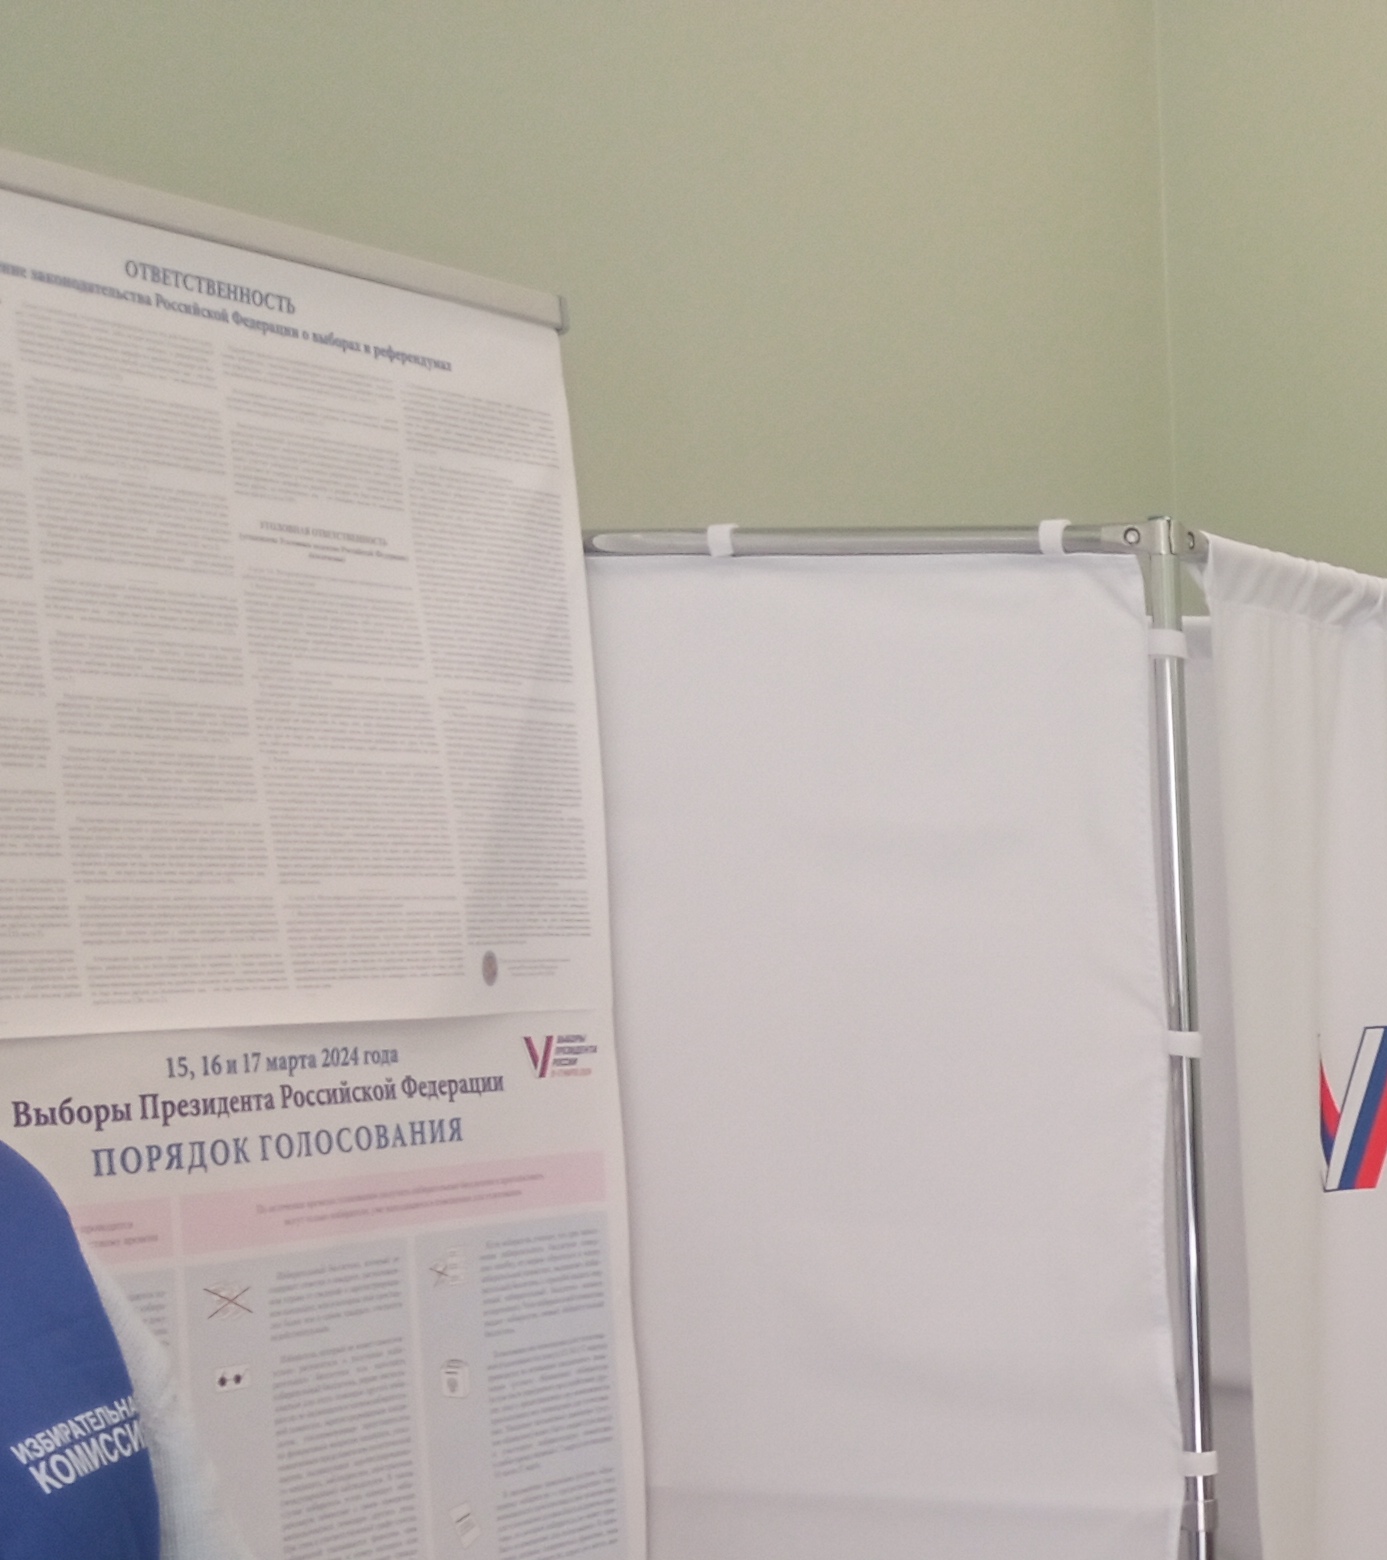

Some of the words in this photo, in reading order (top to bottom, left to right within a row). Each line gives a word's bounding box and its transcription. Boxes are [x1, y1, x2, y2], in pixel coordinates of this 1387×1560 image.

[124, 259, 296, 314] ОТВЕТСТВЕННОСТЬ
[155, 292, 229, 324] Российской
[165, 1056, 195, 1080] 15,
[201, 1054, 222, 1077] 16
[226, 1058, 238, 1075] и
[243, 1052, 262, 1074] 17
[266, 1053, 317, 1077] марта
[321, 1046, 359, 1068] 2024
[363, 1048, 399, 1066] года
[11, 1097, 132, 1131] Выборы
[139, 1092, 275, 1127] Президента
[280, 1077, 397, 1109] Российской
[401, 1075, 504, 1102] Федерации
[91, 1137, 250, 1177] ПОРЯДОК
[259, 1117, 463, 1161] ГОЛОСОВАНИЯ
